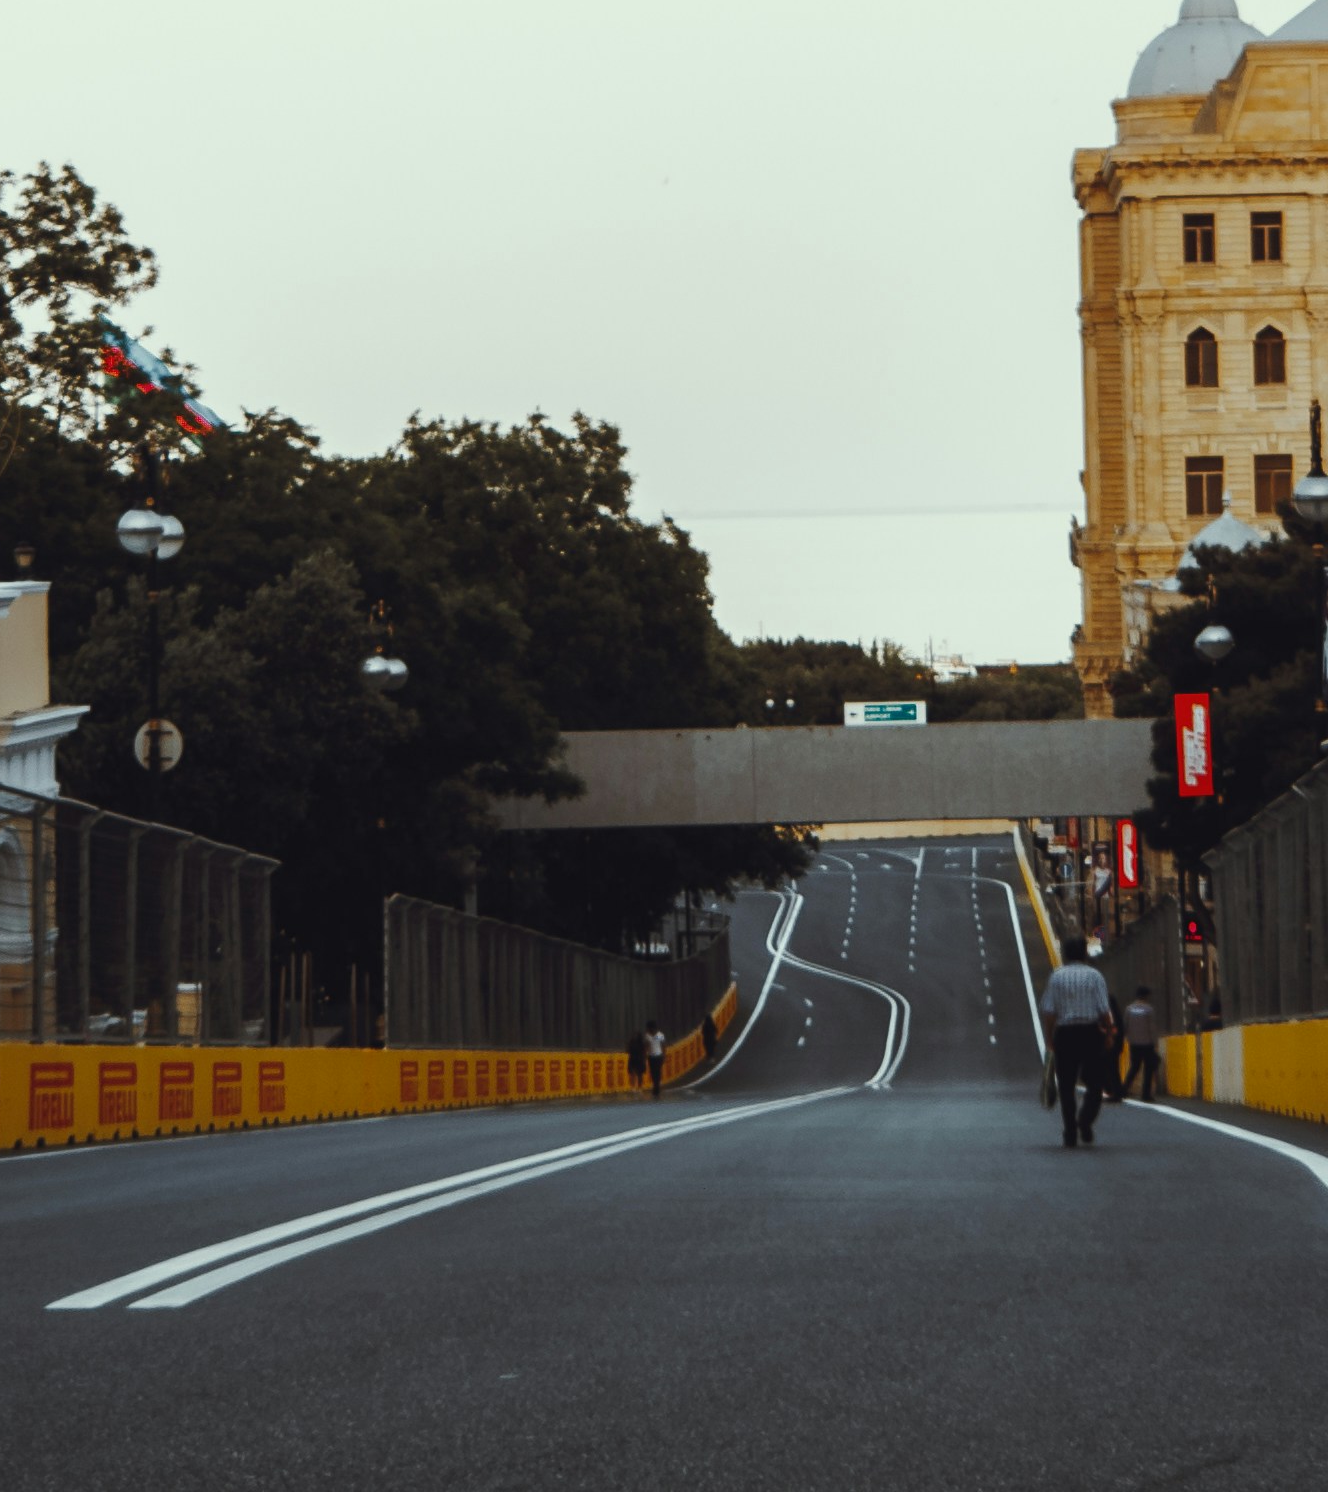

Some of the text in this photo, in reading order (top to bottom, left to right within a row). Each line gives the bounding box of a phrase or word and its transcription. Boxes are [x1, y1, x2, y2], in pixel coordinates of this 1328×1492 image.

[28, 1062, 74, 1131] PIRELLI
[99, 1062, 137, 1125] PIRELLI
[159, 1062, 194, 1120] PIRELLI
